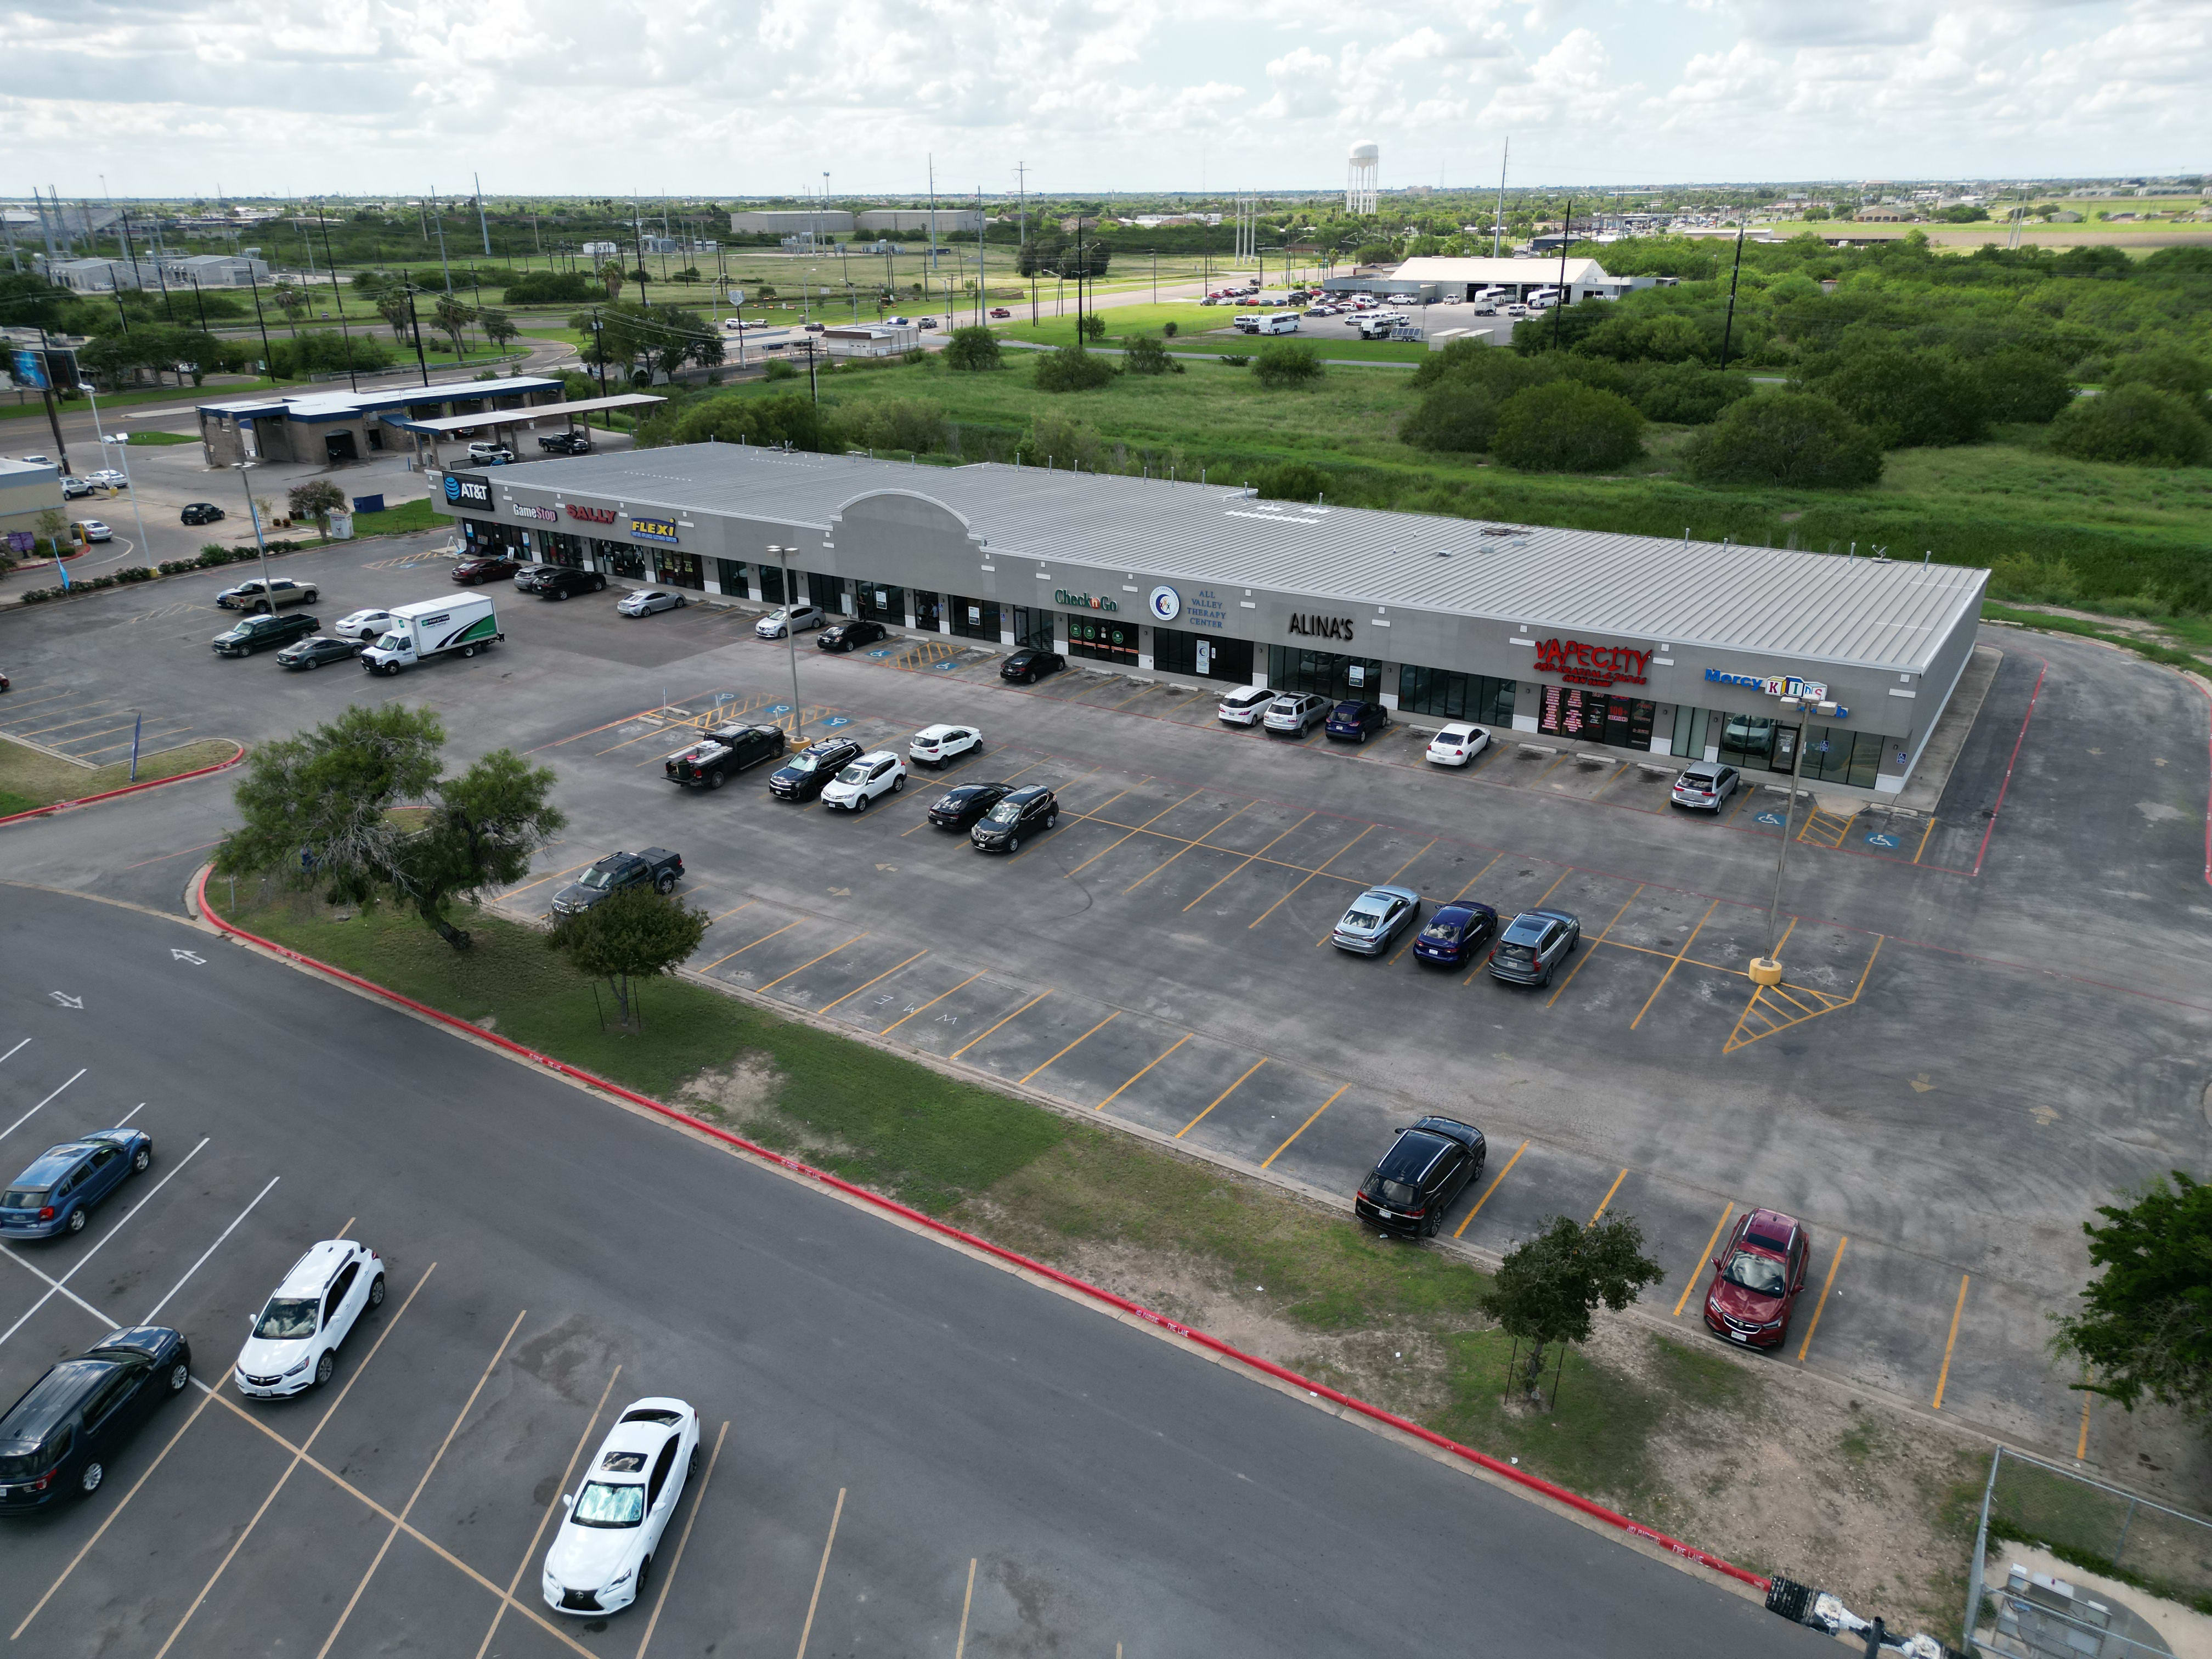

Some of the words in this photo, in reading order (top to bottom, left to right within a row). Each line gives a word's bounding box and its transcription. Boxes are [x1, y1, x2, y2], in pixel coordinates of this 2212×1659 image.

[461, 483, 487, 500] AT&T
[513, 503, 557, 522] GameStop
[566, 504, 616, 522] SALLY
[1055, 589, 1091, 607] Check
[1101, 596, 1118, 611] Go
[1199, 590, 1215, 599] ALL
[1187, 607, 1226, 619] THERAPY
[1192, 599, 1223, 609] VALLEY
[1190, 617, 1223, 629] CENTER
[1290, 613, 1353, 640] ALINA'S
[1536, 638, 1652, 676] VAPECITY
[1705, 668, 1763, 691] Mercy
[1672, 1544, 1686, 1557] FIRE
[1688, 1551, 1704, 1565] LANE
